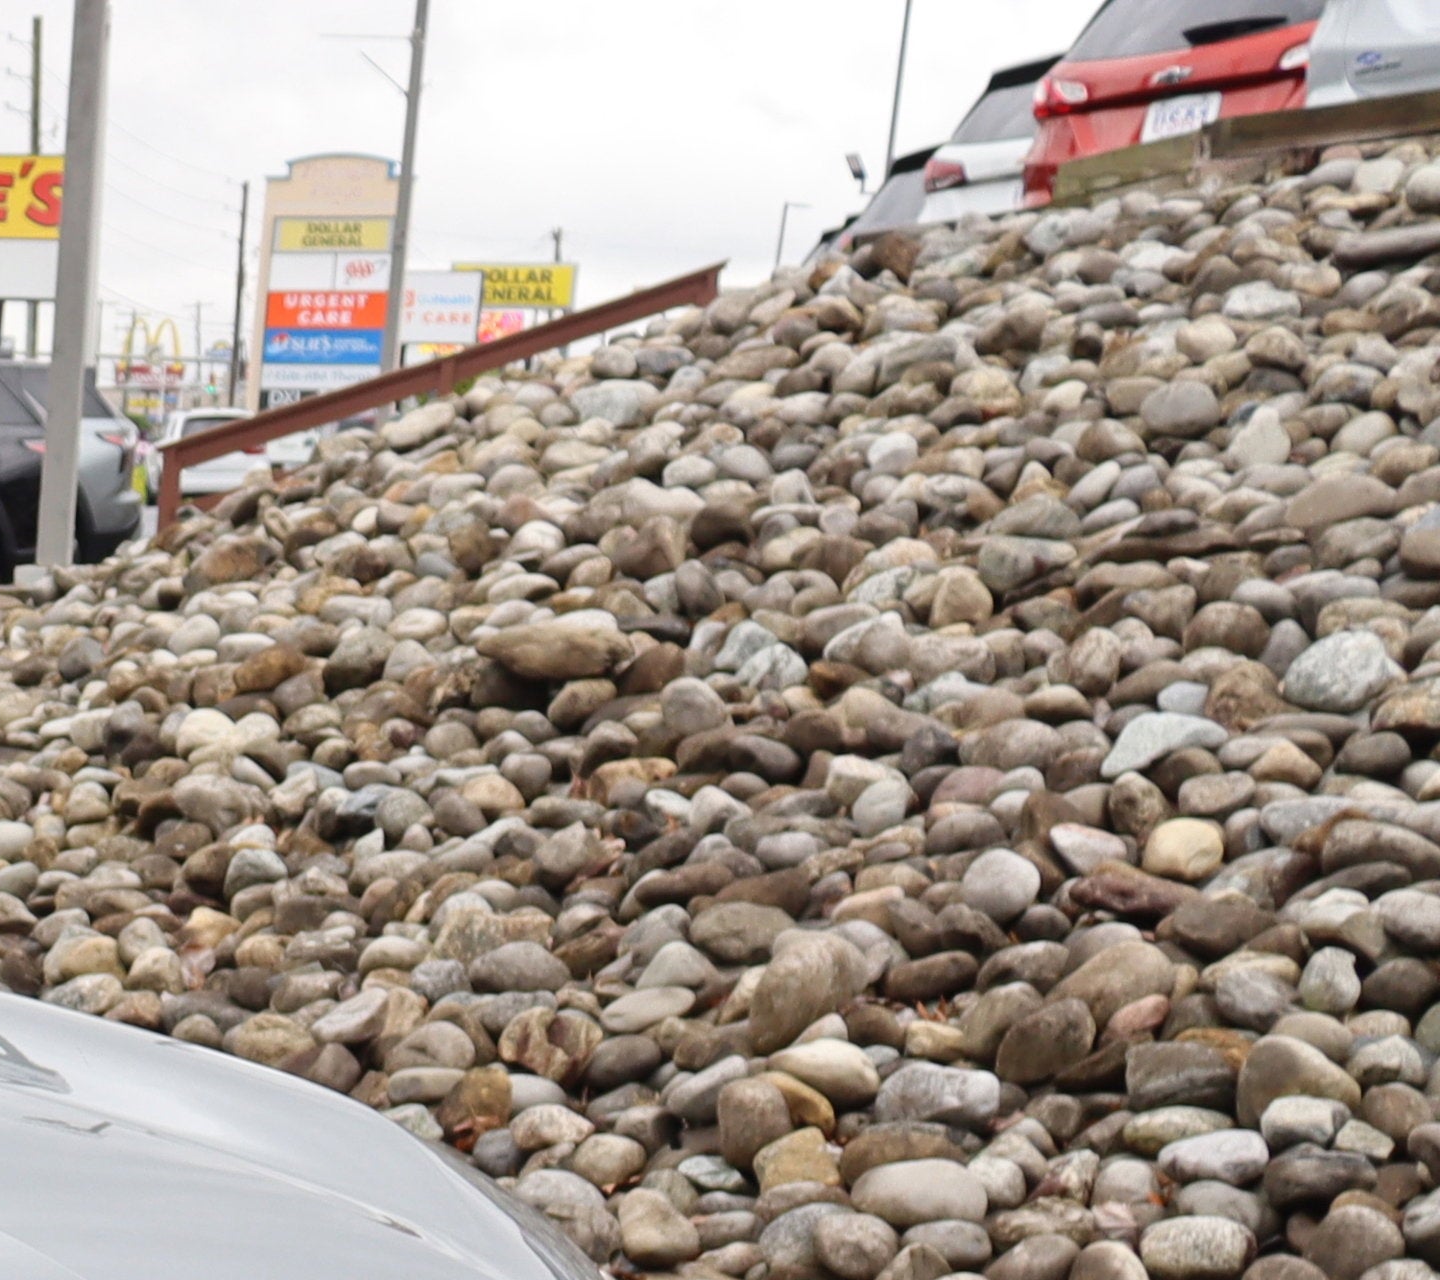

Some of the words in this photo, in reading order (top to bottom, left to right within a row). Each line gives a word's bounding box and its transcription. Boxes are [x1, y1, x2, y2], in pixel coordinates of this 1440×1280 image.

[307, 222, 362, 234] DOLLAR
[302, 234, 363, 247] GENERAL
[283, 294, 369, 309] URGENT
[297, 310, 353, 326] CARE
